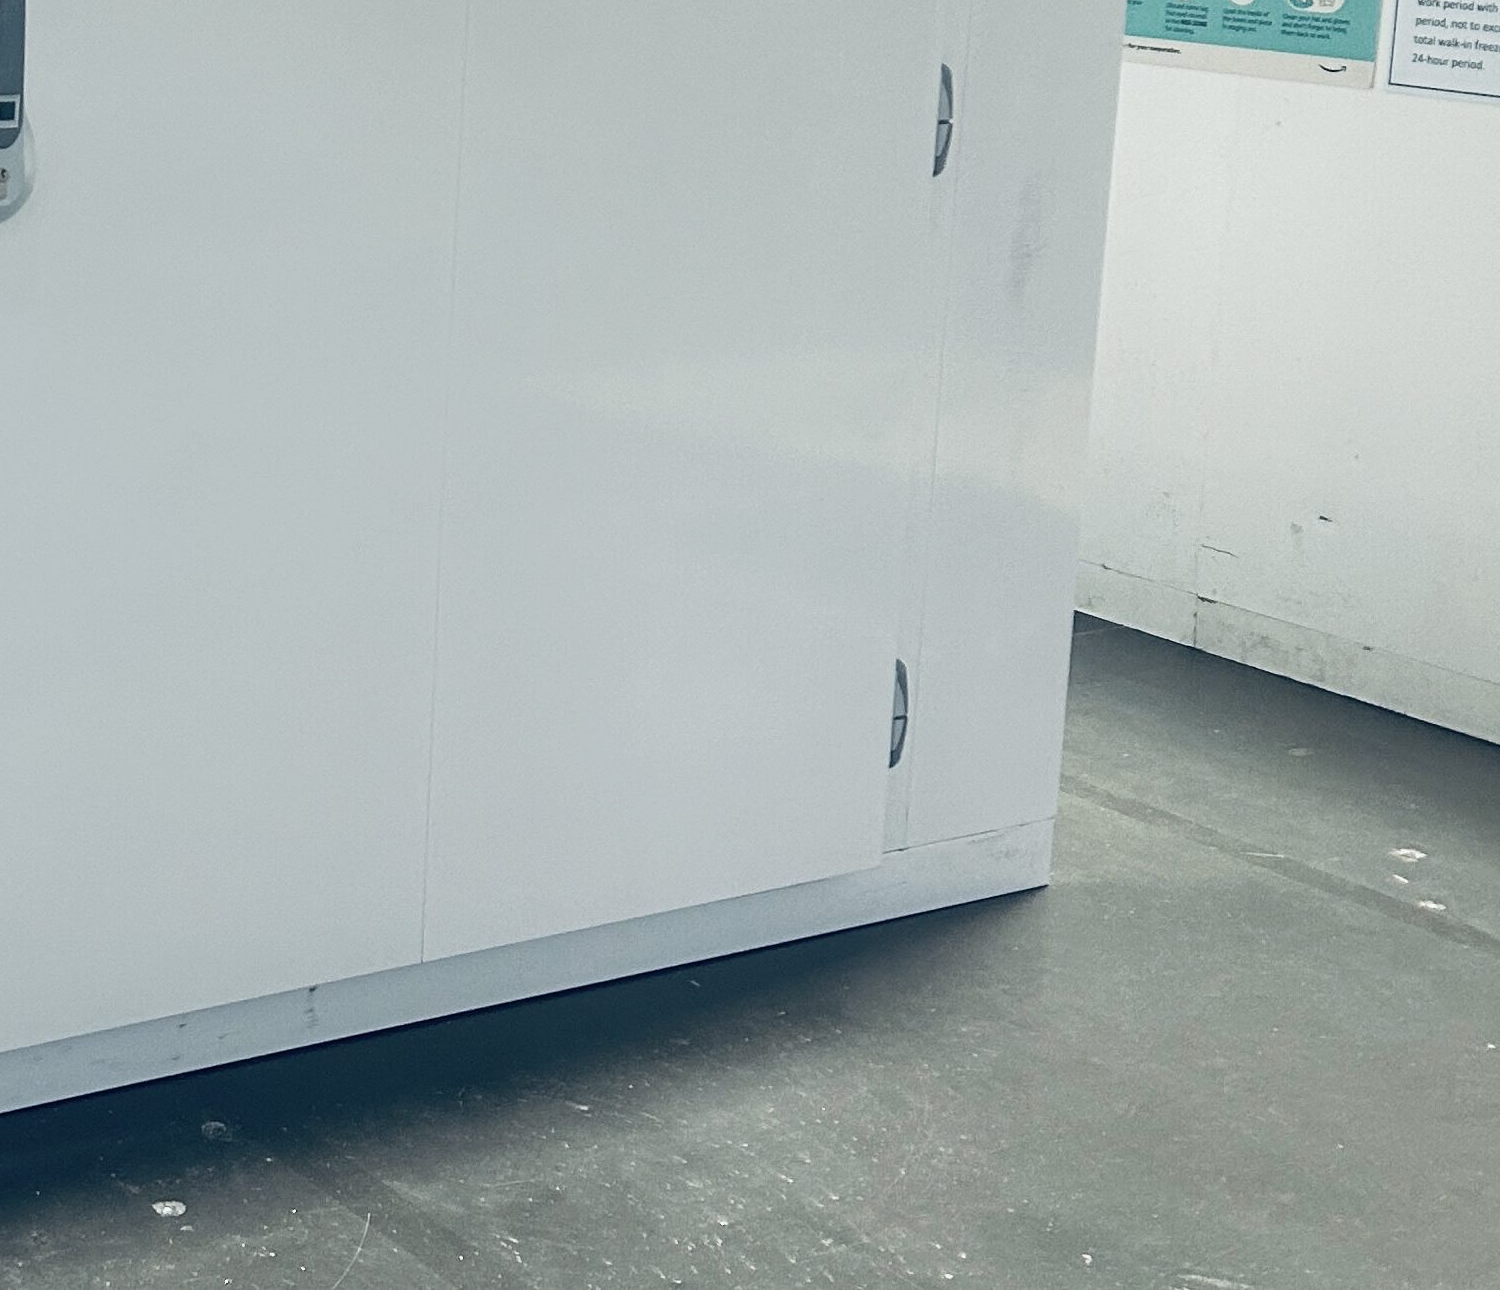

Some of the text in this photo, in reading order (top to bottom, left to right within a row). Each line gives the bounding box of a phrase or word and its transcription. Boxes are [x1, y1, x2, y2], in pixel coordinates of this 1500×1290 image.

[1443, 0, 1475, 11] period
[1477, 2, 1498, 13] with
[1415, 17, 1448, 29] period,
[1451, 20, 1468, 29] not
[1470, 21, 1480, 31] to
[1413, 36, 1436, 45] total
[1438, 37, 1472, 49] walk-in
[1412, 53, 1449, 66] 24-hour
